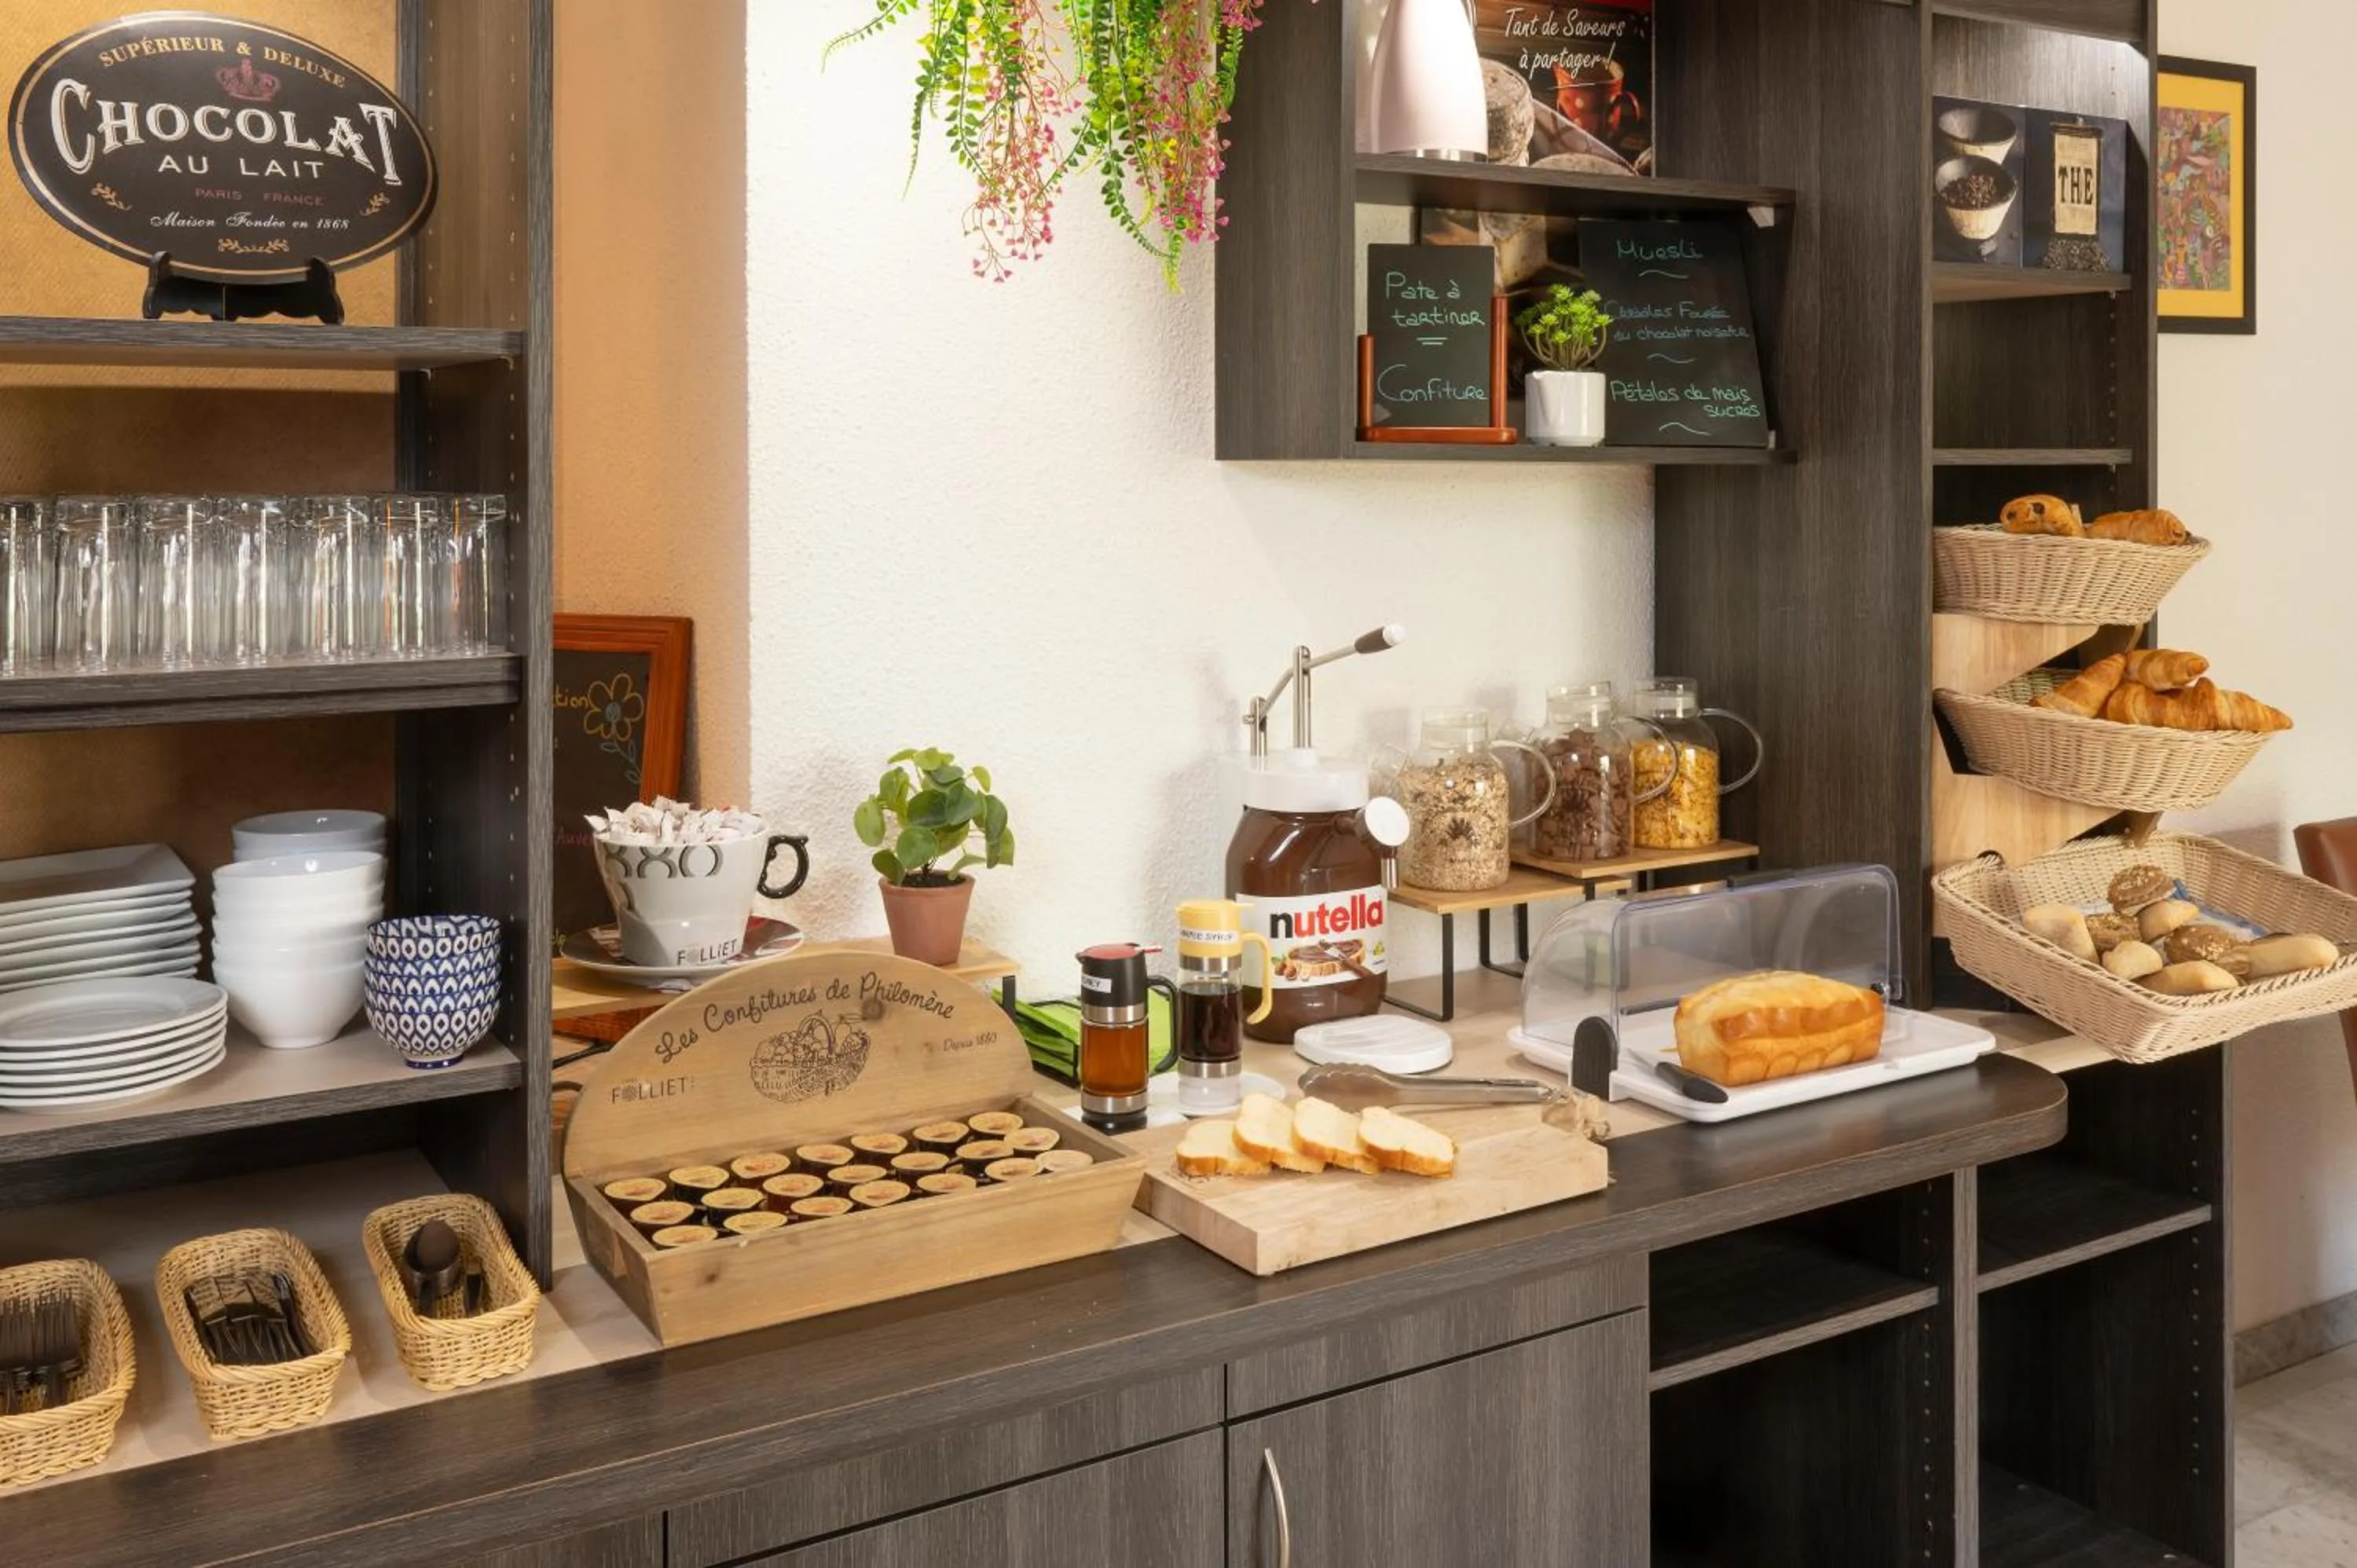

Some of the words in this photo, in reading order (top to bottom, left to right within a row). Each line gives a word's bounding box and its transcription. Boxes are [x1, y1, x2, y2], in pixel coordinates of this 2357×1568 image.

[1505, 7, 1539, 37] Tant
[1541, 10, 1560, 36] de
[1563, 8, 1626, 38] Saveurs
[99, 36, 225, 68] SUPÉRIEUR
[236, 42, 252, 57] &
[264, 46, 346, 90] DELUXE
[1519, 47, 1529, 69] à
[50, 78, 401, 185] CHOCOLAT
[158, 155, 209, 174] AU
[240, 158, 324, 178] LAIT
[196, 188, 242, 200] PARIS
[262, 192, 324, 206] FRANCE
[2058, 165, 2093, 205] THE
[150, 211, 216, 228] Maison
[225, 211, 286, 229] Fondée
[291, 220, 308, 229] en
[316, 218, 349, 229] 1868
[1616, 238, 1706, 261] Muesli
[1386, 271, 1439, 299] Pate
[1446, 279, 1461, 299] à
[1377, 364, 1488, 402] Confiture
[1684, 383, 1710, 400] de
[552, 683, 588, 709] tion
[1270, 893, 1384, 939] nutella
[654, 1028, 698, 1064] Les
[703, 987, 817, 1033] Confitures
[825, 978, 851, 1001] de
[860, 971, 955, 1020] Philomène
